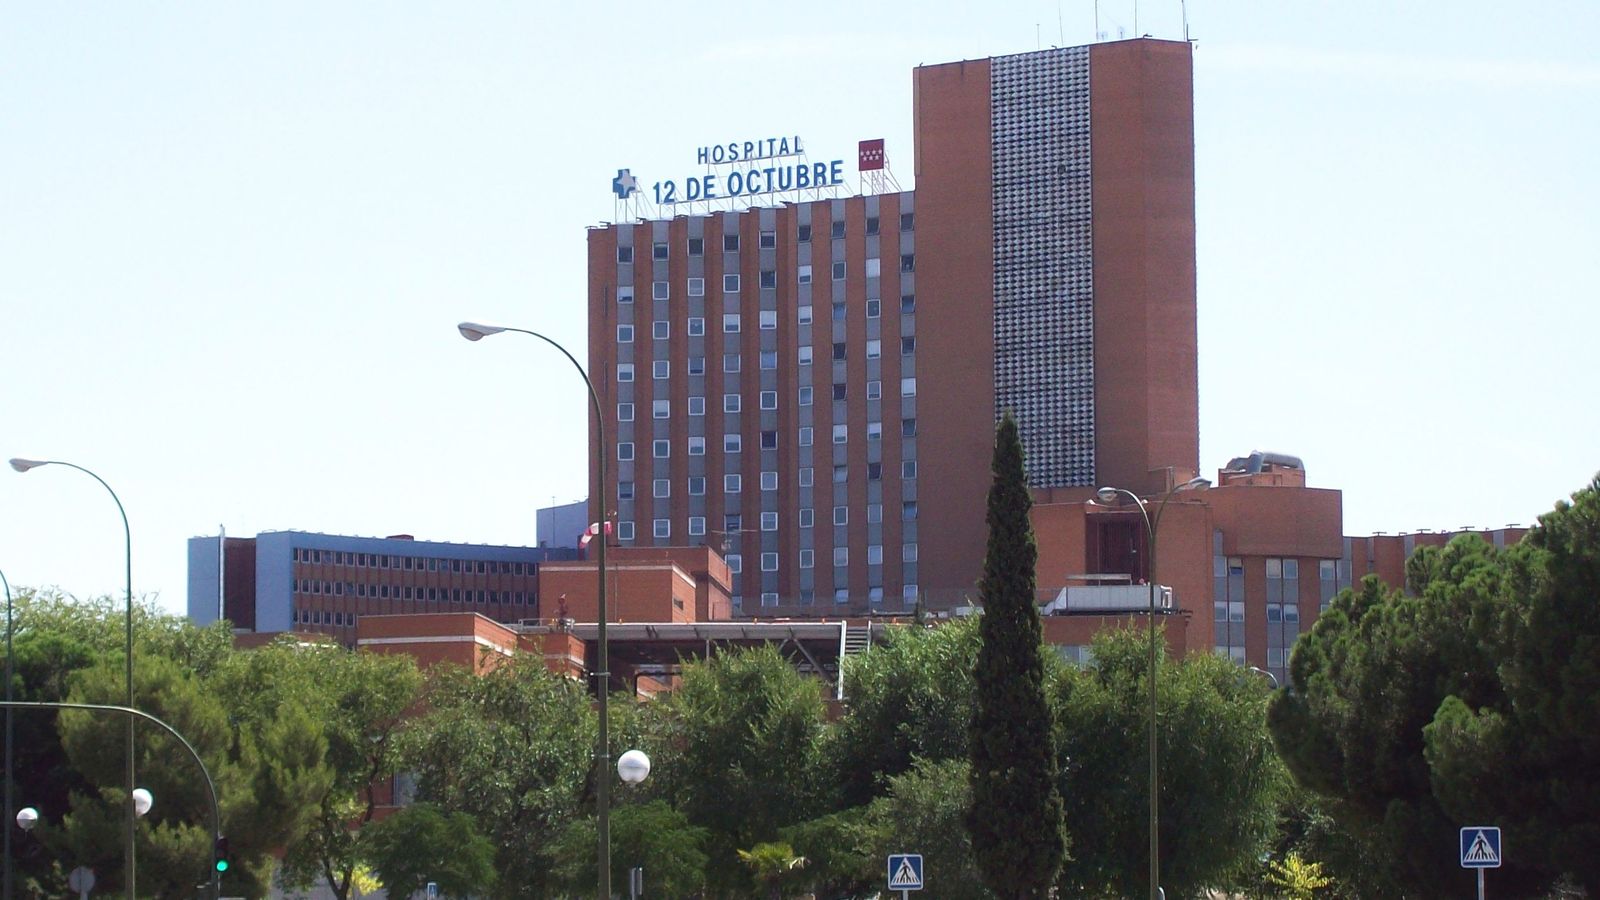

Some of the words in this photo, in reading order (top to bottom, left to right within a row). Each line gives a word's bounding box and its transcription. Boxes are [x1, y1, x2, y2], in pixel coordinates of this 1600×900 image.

[698, 136, 803, 164] HOSPITAL
[653, 181, 675, 204] 12
[686, 175, 715, 200] DE
[727, 160, 844, 195] OCTUBRE
